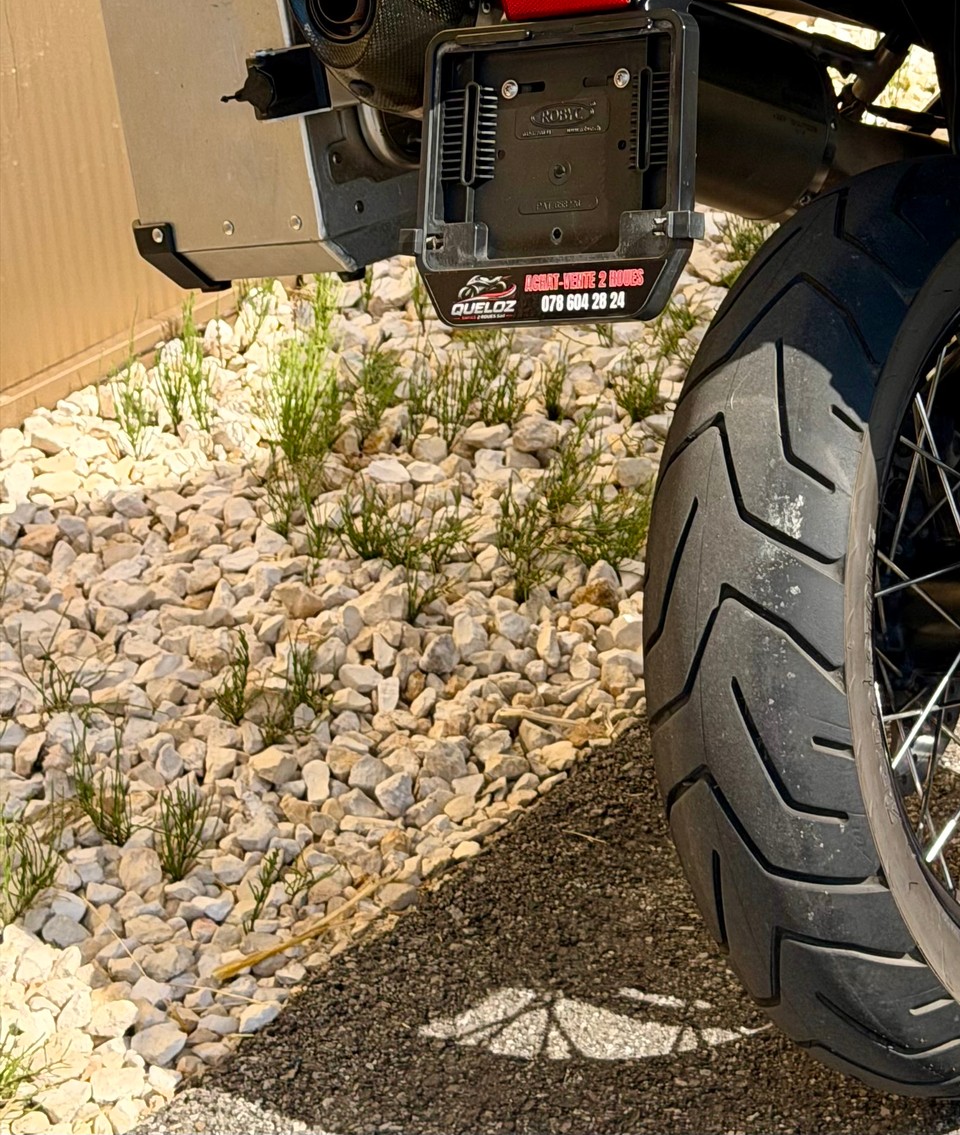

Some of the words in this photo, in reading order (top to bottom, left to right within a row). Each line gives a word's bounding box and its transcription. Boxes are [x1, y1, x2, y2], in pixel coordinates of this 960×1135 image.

[524, 271, 597, 292] ACHAT-VENTE
[598, 270, 607, 288] 2
[609, 268, 645, 288] ROUES
[450, 300, 517, 317] QUELOZ
[541, 294, 564, 313] 078
[566, 292, 590, 311] 604
[591, 291, 608, 310] 28
[609, 290, 626, 309] 24
